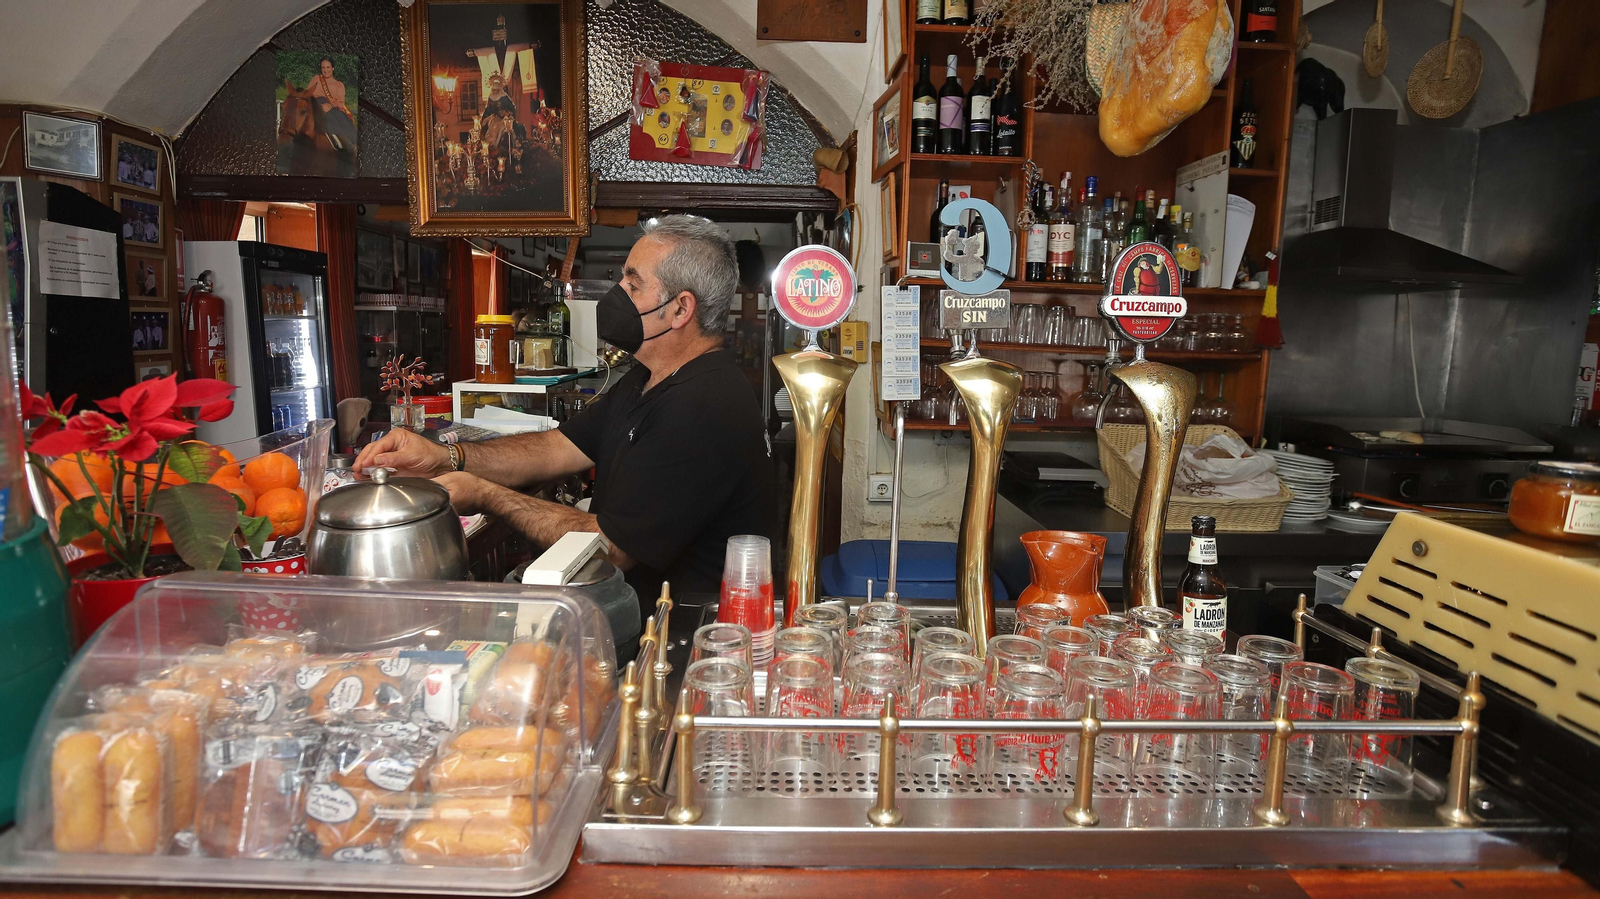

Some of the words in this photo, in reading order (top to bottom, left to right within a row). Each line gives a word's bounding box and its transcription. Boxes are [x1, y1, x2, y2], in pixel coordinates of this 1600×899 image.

[1050, 231, 1071, 240] DYC
[1128, 247, 1145, 260] CAMPO
[788, 278, 841, 297] LATINO
[944, 296, 1006, 310] Cruzcampo
[1110, 297, 1182, 315] Cruzcampo
[962, 310, 987, 322] SIN
[1193, 620, 1201, 628] DE
